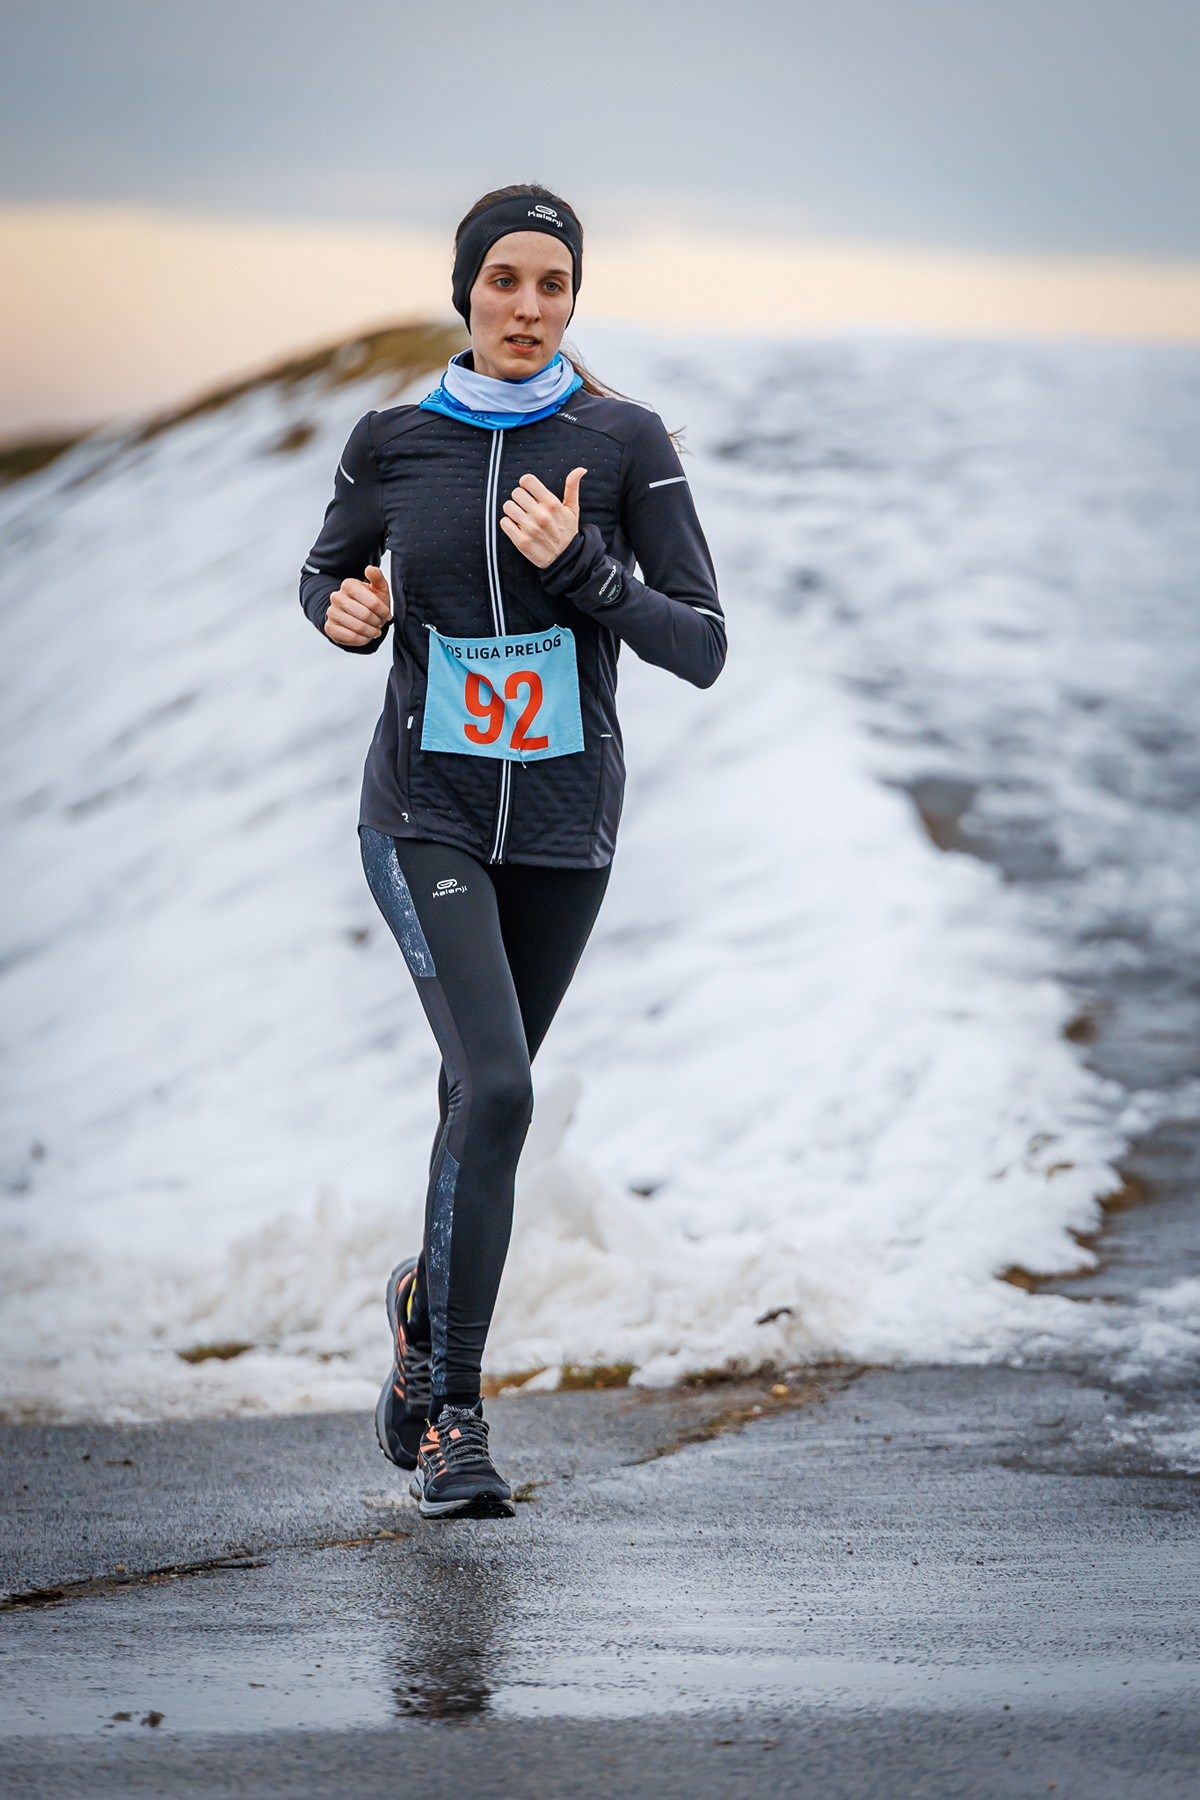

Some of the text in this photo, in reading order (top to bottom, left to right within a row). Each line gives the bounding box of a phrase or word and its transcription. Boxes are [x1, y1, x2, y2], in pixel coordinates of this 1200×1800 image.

[527, 210, 563, 228] Kalenji
[466, 645, 501, 660] LIGA
[505, 634, 562, 658] PRELOG
[463, 670, 549, 751] 92
[432, 885, 468, 899] Kalenji
